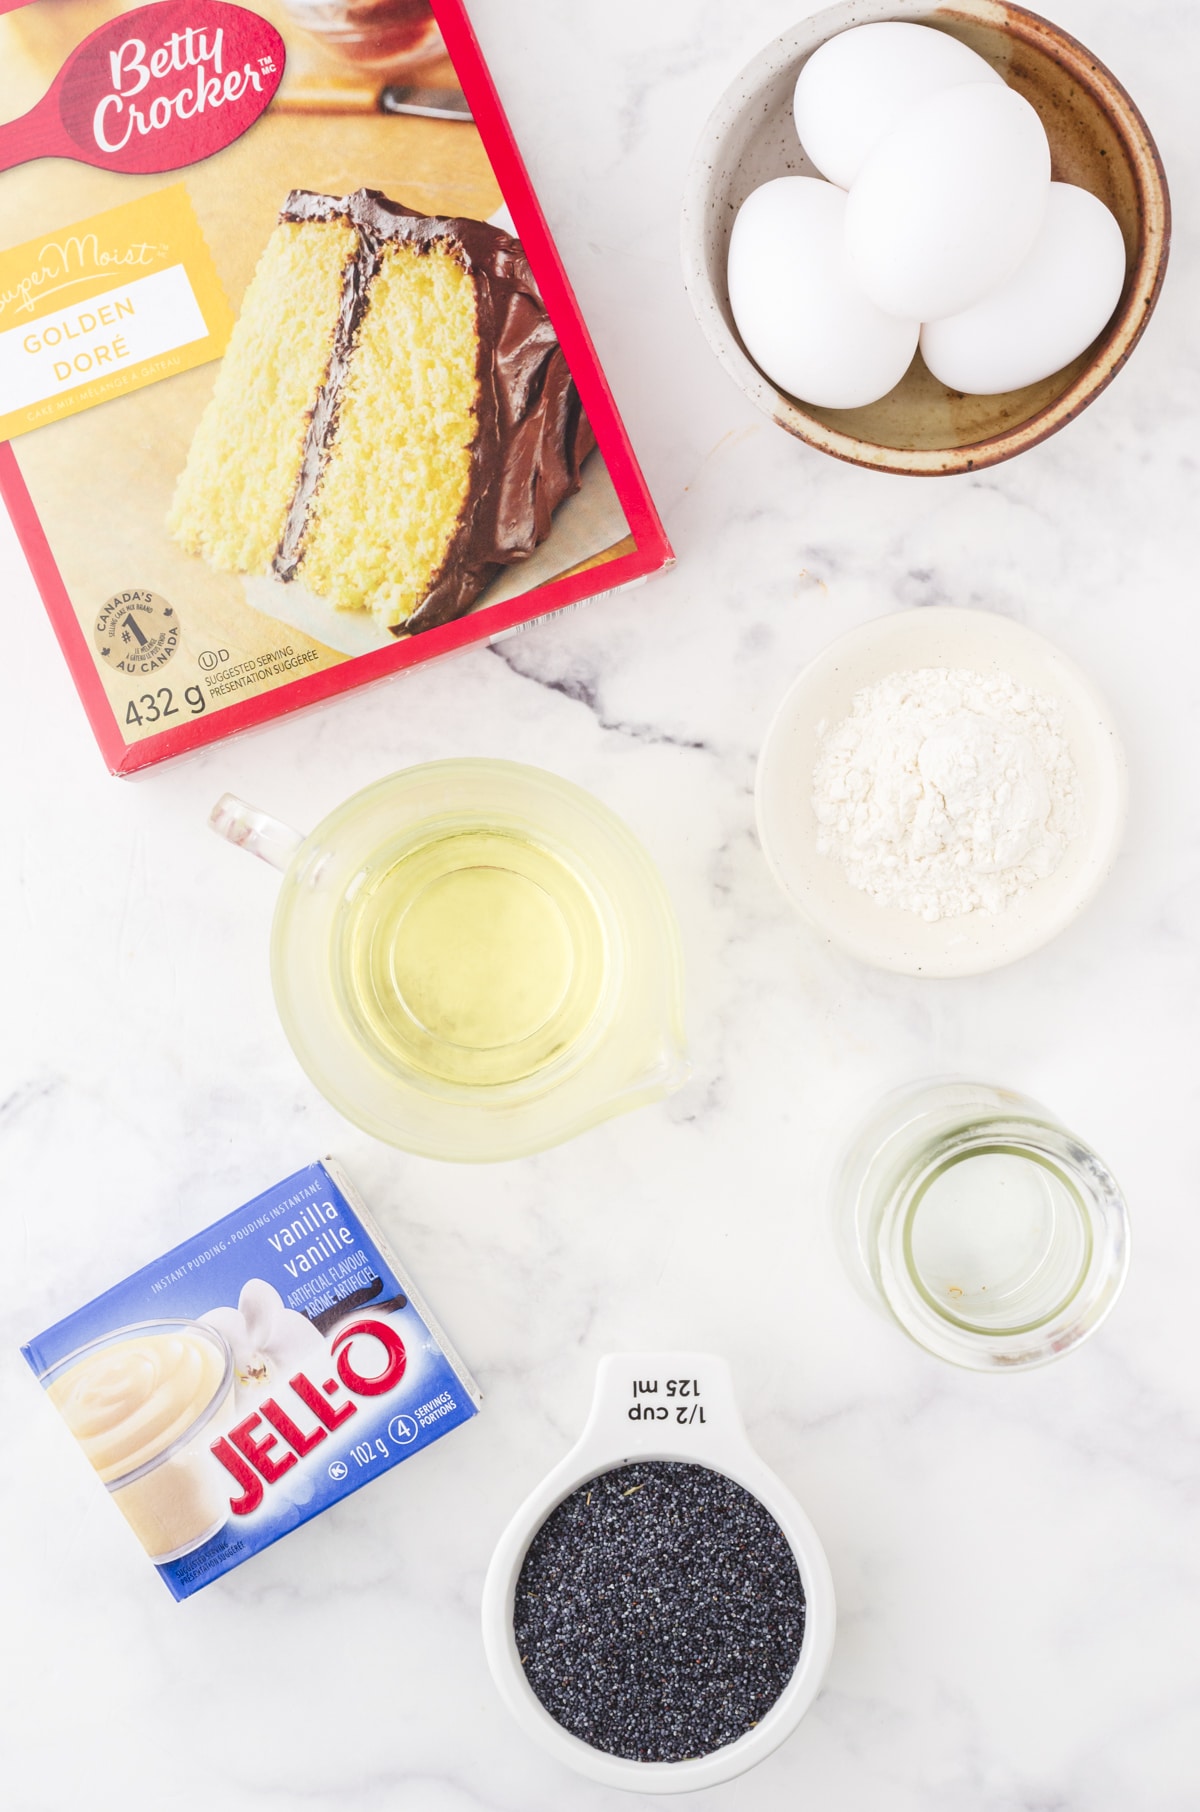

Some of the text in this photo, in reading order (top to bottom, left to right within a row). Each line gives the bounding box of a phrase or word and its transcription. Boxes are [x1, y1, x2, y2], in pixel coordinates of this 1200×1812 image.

[110, 27, 223, 97] Betty
[258, 56, 272, 66] TM
[261, 64, 276, 75] MC
[93, 64, 263, 152] Crocker
[23, 297, 135, 354] GOLDEN
[53, 334, 130, 381] DORÉ
[26, 405, 54, 422] CAKE
[56, 397, 75, 412] MIX
[97, 591, 153, 632] CANADA'S
[116, 626, 179, 673] AU CANADA
[205, 645, 294, 687] SUGGESTED SERVING
[209, 649, 319, 699] PRÉSENTATION SUGGÉRÉE
[125, 684, 206, 727] 432 g
[151, 1179, 322, 1294] INSTANT PUDDING POUDING INSTANTANÉ
[267, 1201, 339, 1253] vanilla
[283, 1226, 355, 1278] vanille
[286, 1249, 369, 1308] ARTIFICIAL FLAVOUR
[304, 1265, 379, 1320] ARÔME ARTIFICIEL
[413, 1391, 452, 1420] SERVINGS
[633, 1380, 701, 1398] 125 ml
[396, 1418, 412, 1440] 4
[419, 1399, 457, 1429] PORTIONS
[628, 1403, 706, 1425] 1/2 cup
[350, 1438, 389, 1467] 102 g
